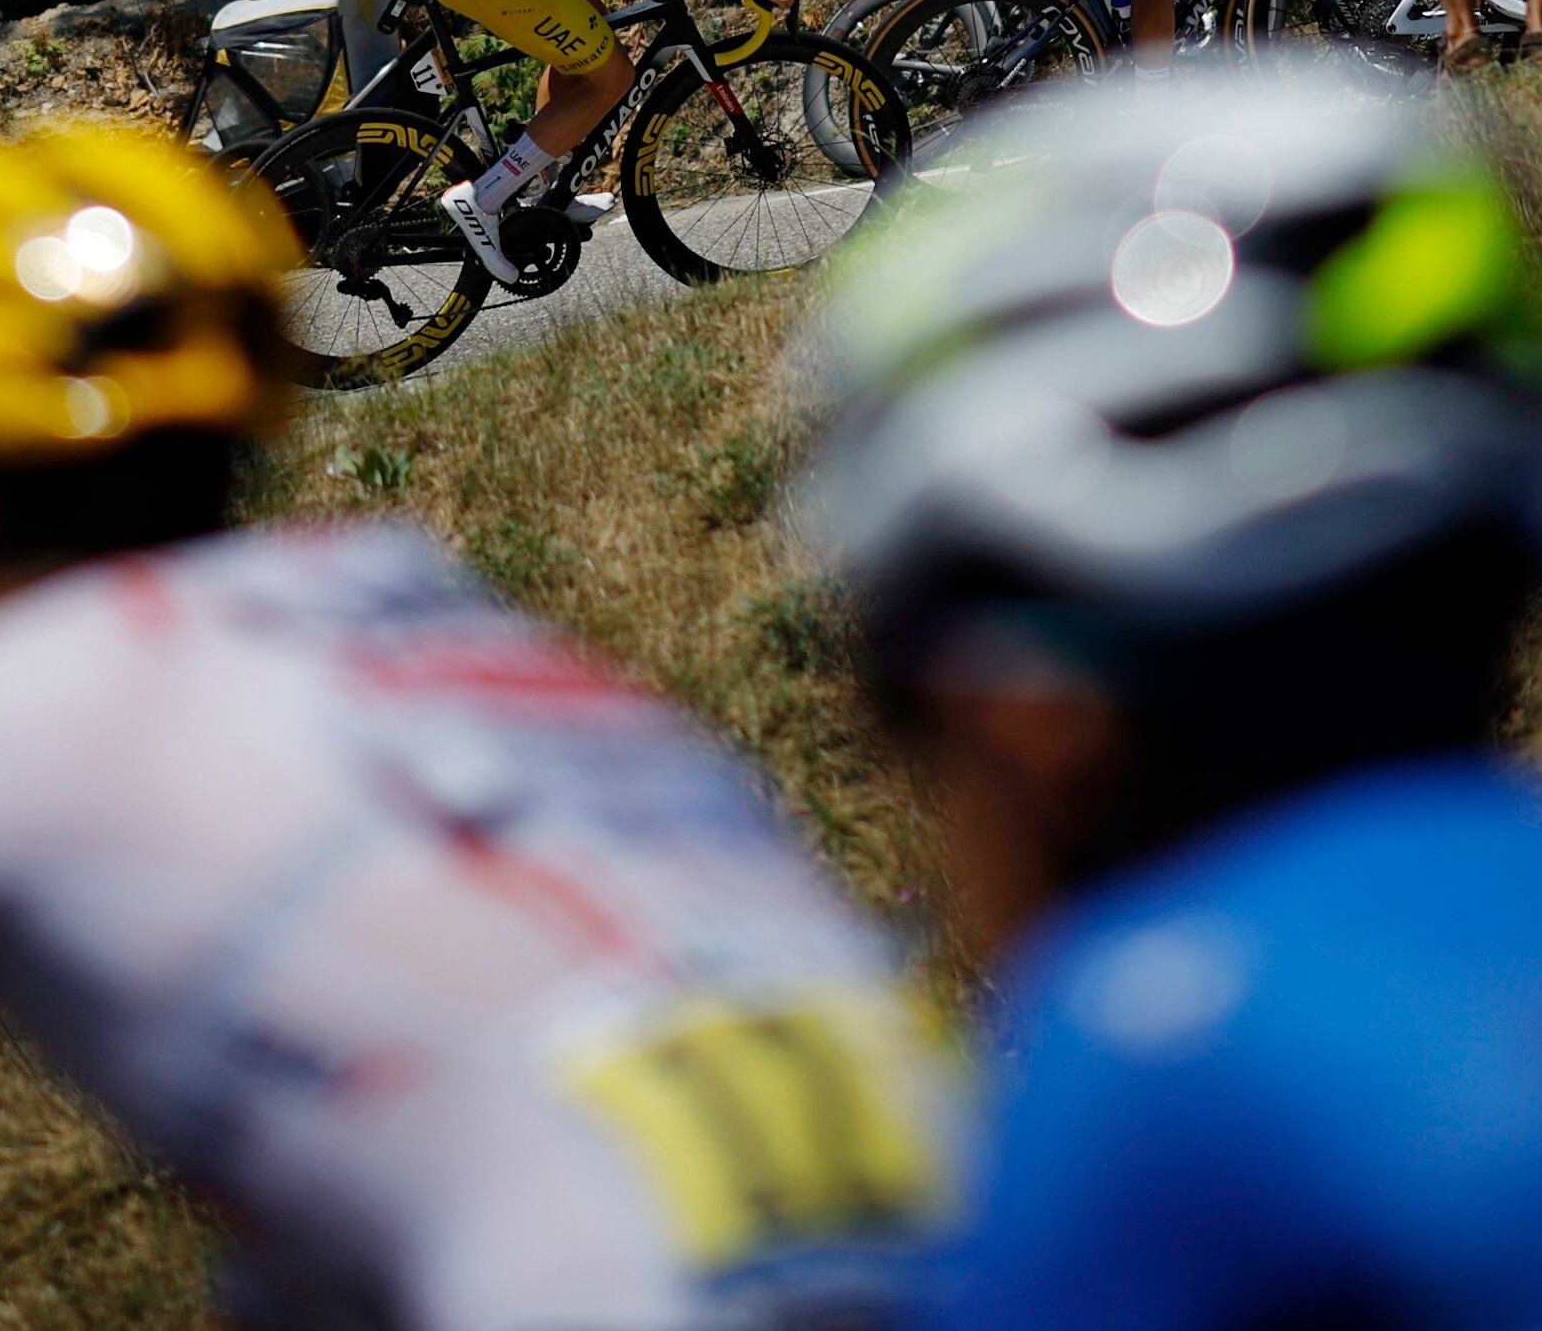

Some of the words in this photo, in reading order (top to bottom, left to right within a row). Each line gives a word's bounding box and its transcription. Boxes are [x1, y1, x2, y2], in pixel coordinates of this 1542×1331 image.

[533, 15, 587, 57] UAE
[412, 64, 439, 90] 11
[569, 67, 658, 194] COLNAGO
[509, 150, 531, 170] UAE
